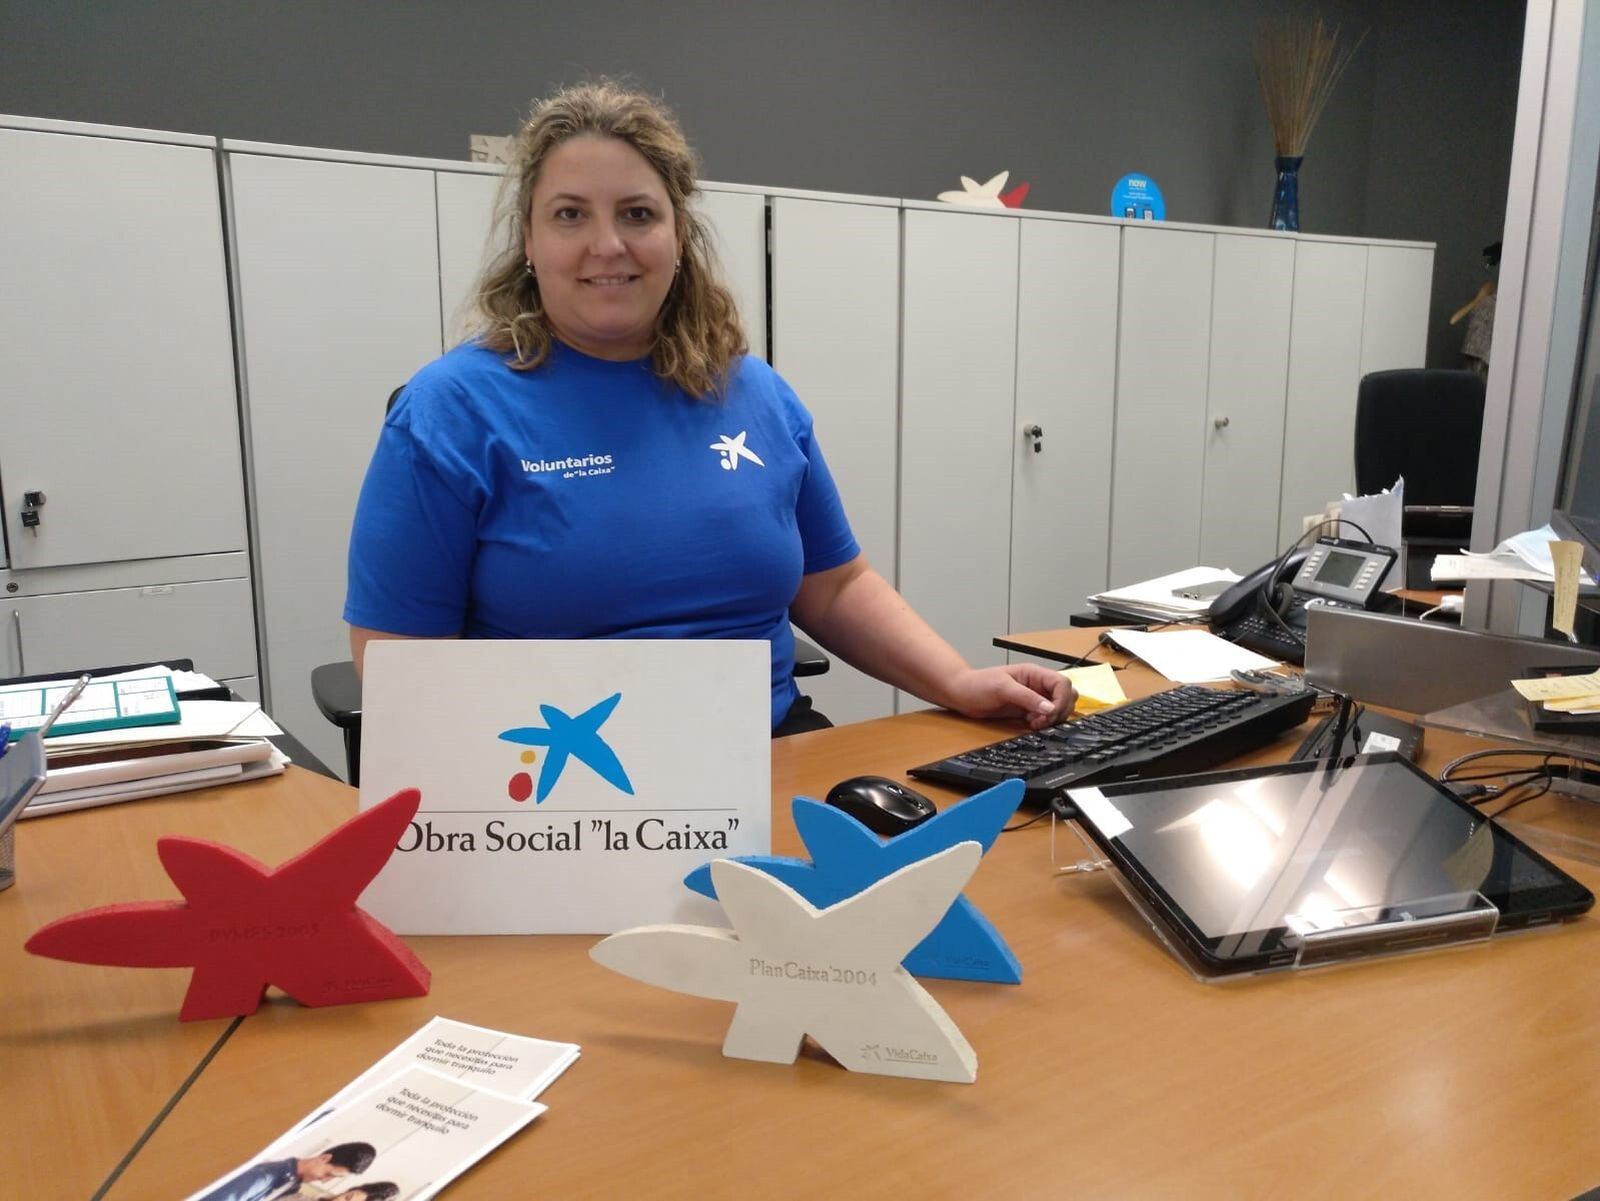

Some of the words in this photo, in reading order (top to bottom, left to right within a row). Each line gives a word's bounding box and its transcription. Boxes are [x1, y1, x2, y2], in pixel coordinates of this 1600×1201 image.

[521, 453, 613, 473] Voluntarios
[485, 819, 582, 852] Social
[635, 818, 741, 851] Caixa"
[434, 1038, 457, 1050] Toda
[885, 1047, 938, 1061] VidaCaixa
[416, 1052, 449, 1065] dormir
[451, 1061, 497, 1075] tranquilo
[425, 1046, 445, 1055] que
[445, 1051, 488, 1065] necesitas
[488, 1061, 513, 1070] para
[400, 1088, 421, 1101] Toda
[375, 1103, 408, 1118] dormir
[407, 1115, 450, 1135] tranquilo
[387, 1096, 406, 1106] que
[406, 1103, 446, 1121] necesitas
[445, 1118, 470, 1130] para
